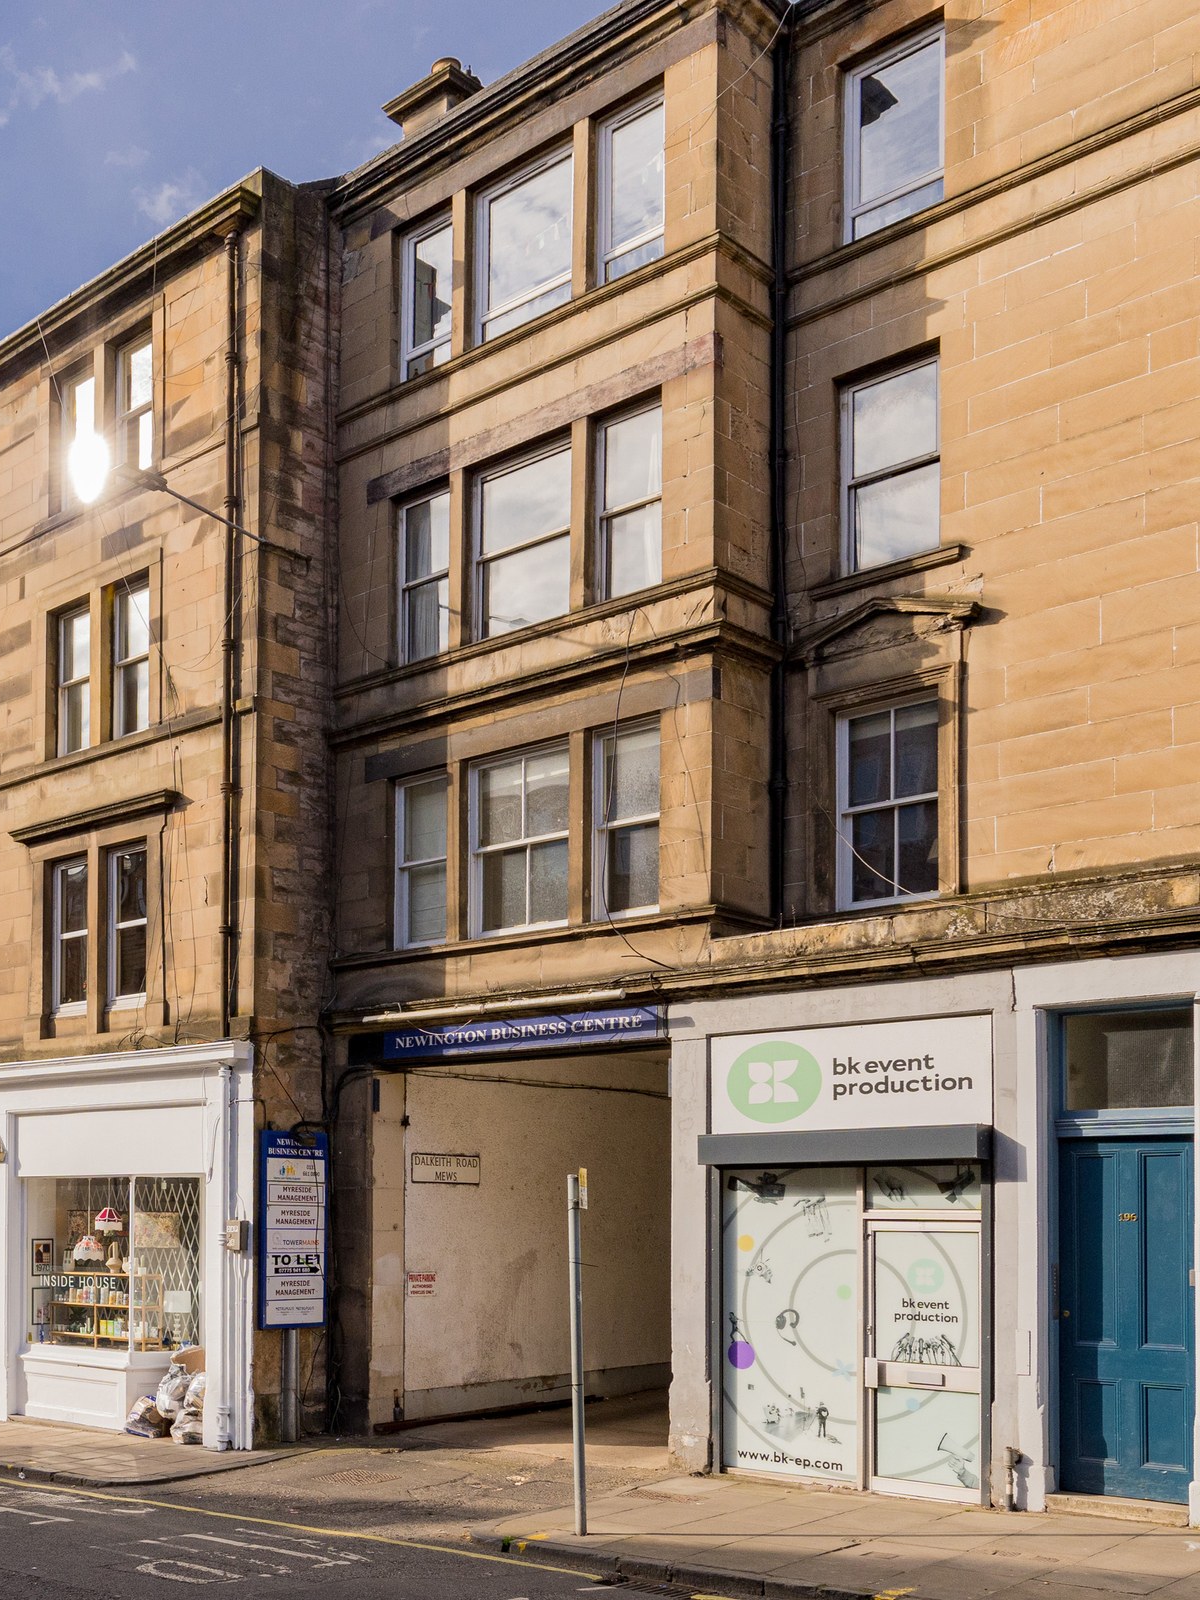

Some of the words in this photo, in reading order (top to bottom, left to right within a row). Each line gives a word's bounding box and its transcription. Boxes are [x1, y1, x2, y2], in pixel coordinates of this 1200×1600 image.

[395, 1029, 487, 1049] NEWINGTON
[491, 1018, 567, 1040] BUSINESS
[571, 1015, 642, 1033] CENTRE
[833, 1057, 860, 1076] bk
[865, 1054, 935, 1074] event
[833, 1073, 973, 1101] production
[268, 1147, 297, 1155] BUSINESS
[414, 1155, 452, 1167] DALKEITH
[456, 1158, 478, 1168] ROAD
[435, 1171, 458, 1181] MEWS
[277, 1194, 317, 1202] MANAGEMENT
[272, 1254, 291, 1265] TO
[296, 1254, 320, 1265] LET
[40, 1275, 74, 1287] INSIDE
[79, 1277, 116, 1289] HOUSE
[275, 1288, 316, 1296] MANAGEMENT
[902, 1298, 915, 1309] bk
[917, 1301, 950, 1310] event
[894, 1311, 959, 1323] production
[737, 1450, 843, 1472] www.bk-ep.com
